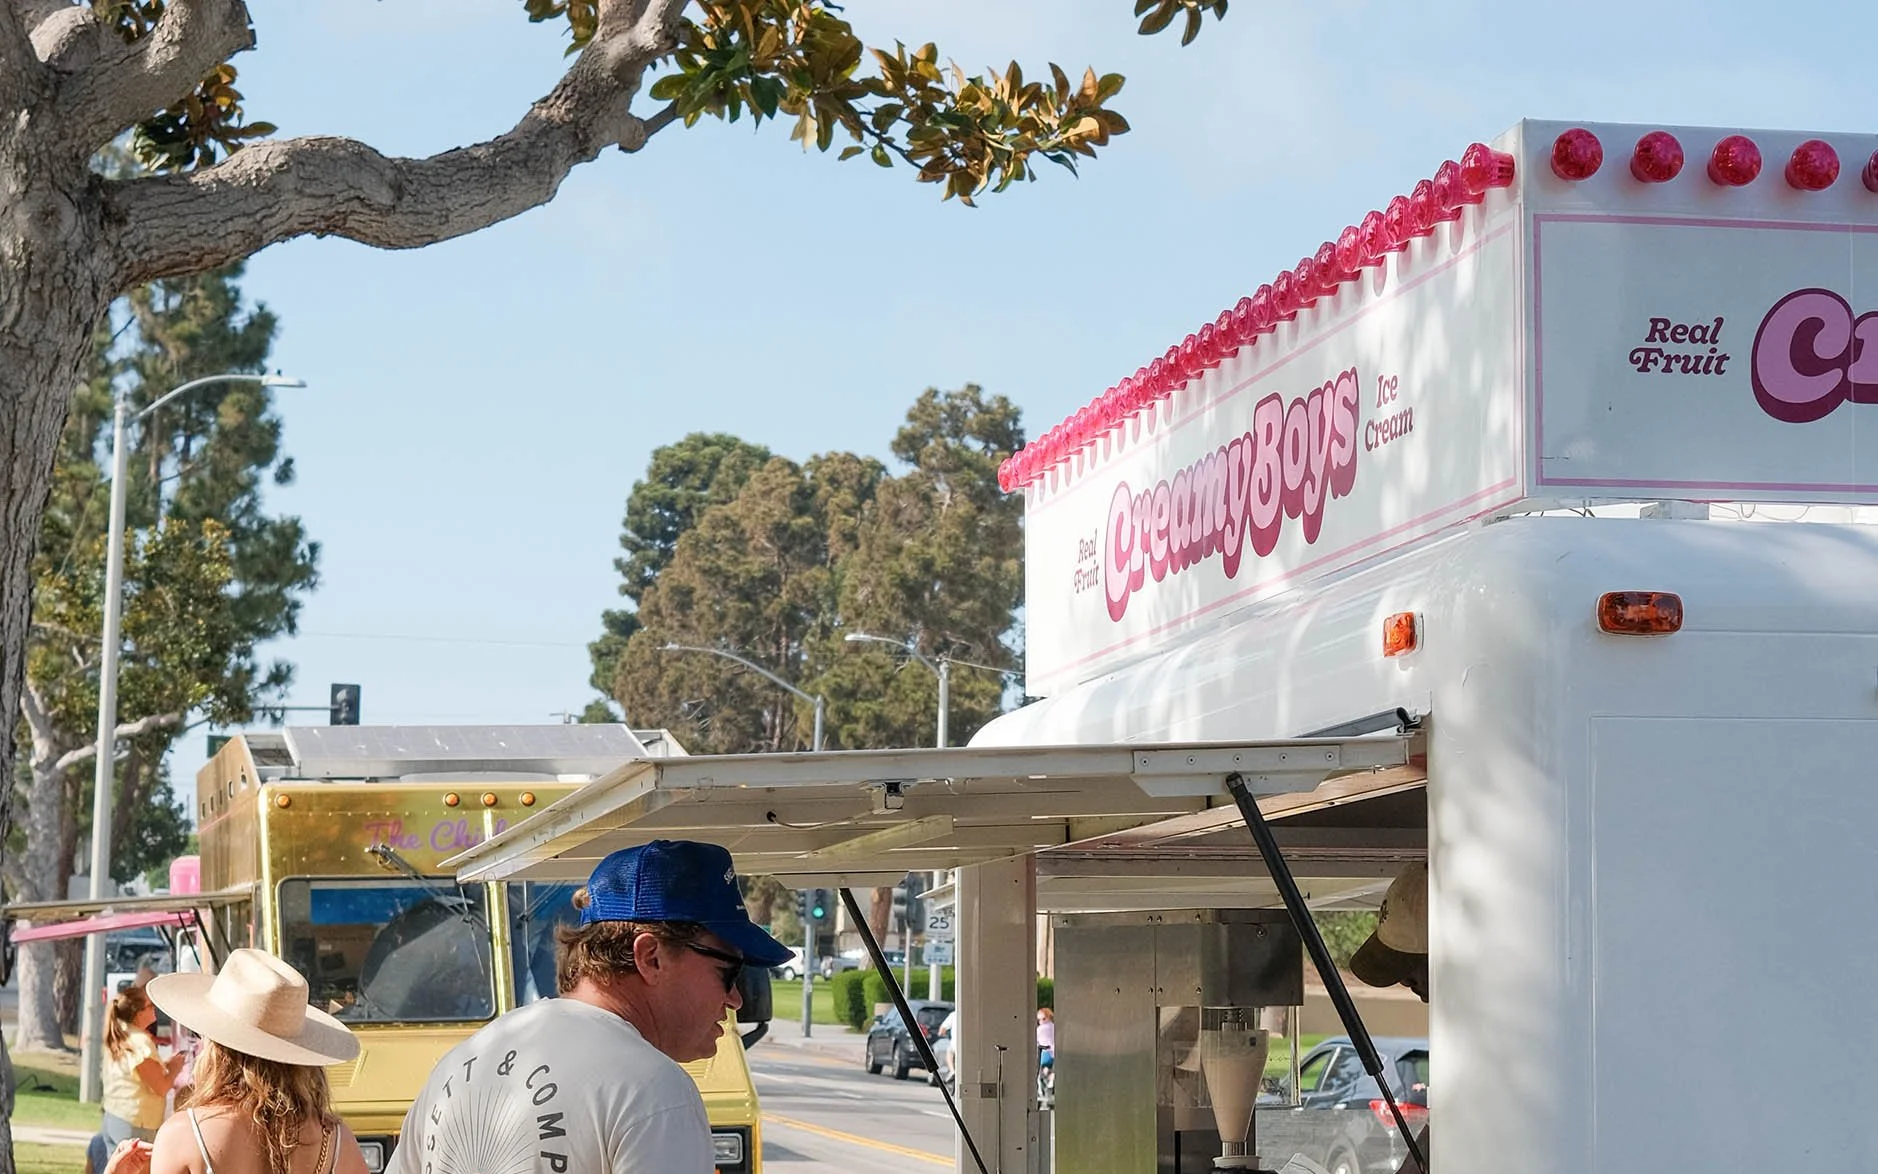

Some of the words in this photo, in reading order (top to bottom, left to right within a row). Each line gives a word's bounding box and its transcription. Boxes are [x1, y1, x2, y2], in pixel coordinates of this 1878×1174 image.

[1645, 316, 1724, 344] Real
[1629, 347, 1730, 375] Fruit
[1376, 374, 1399, 409] Ice
[1365, 405, 1414, 452] Cream
[1077, 528, 1098, 560] Real
[1074, 563, 1099, 594] Fruit
[364, 819, 422, 850] The
[430, 817, 508, 853] Chi
[929, 916, 950, 929] 25
[496, 1050, 518, 1076] &
